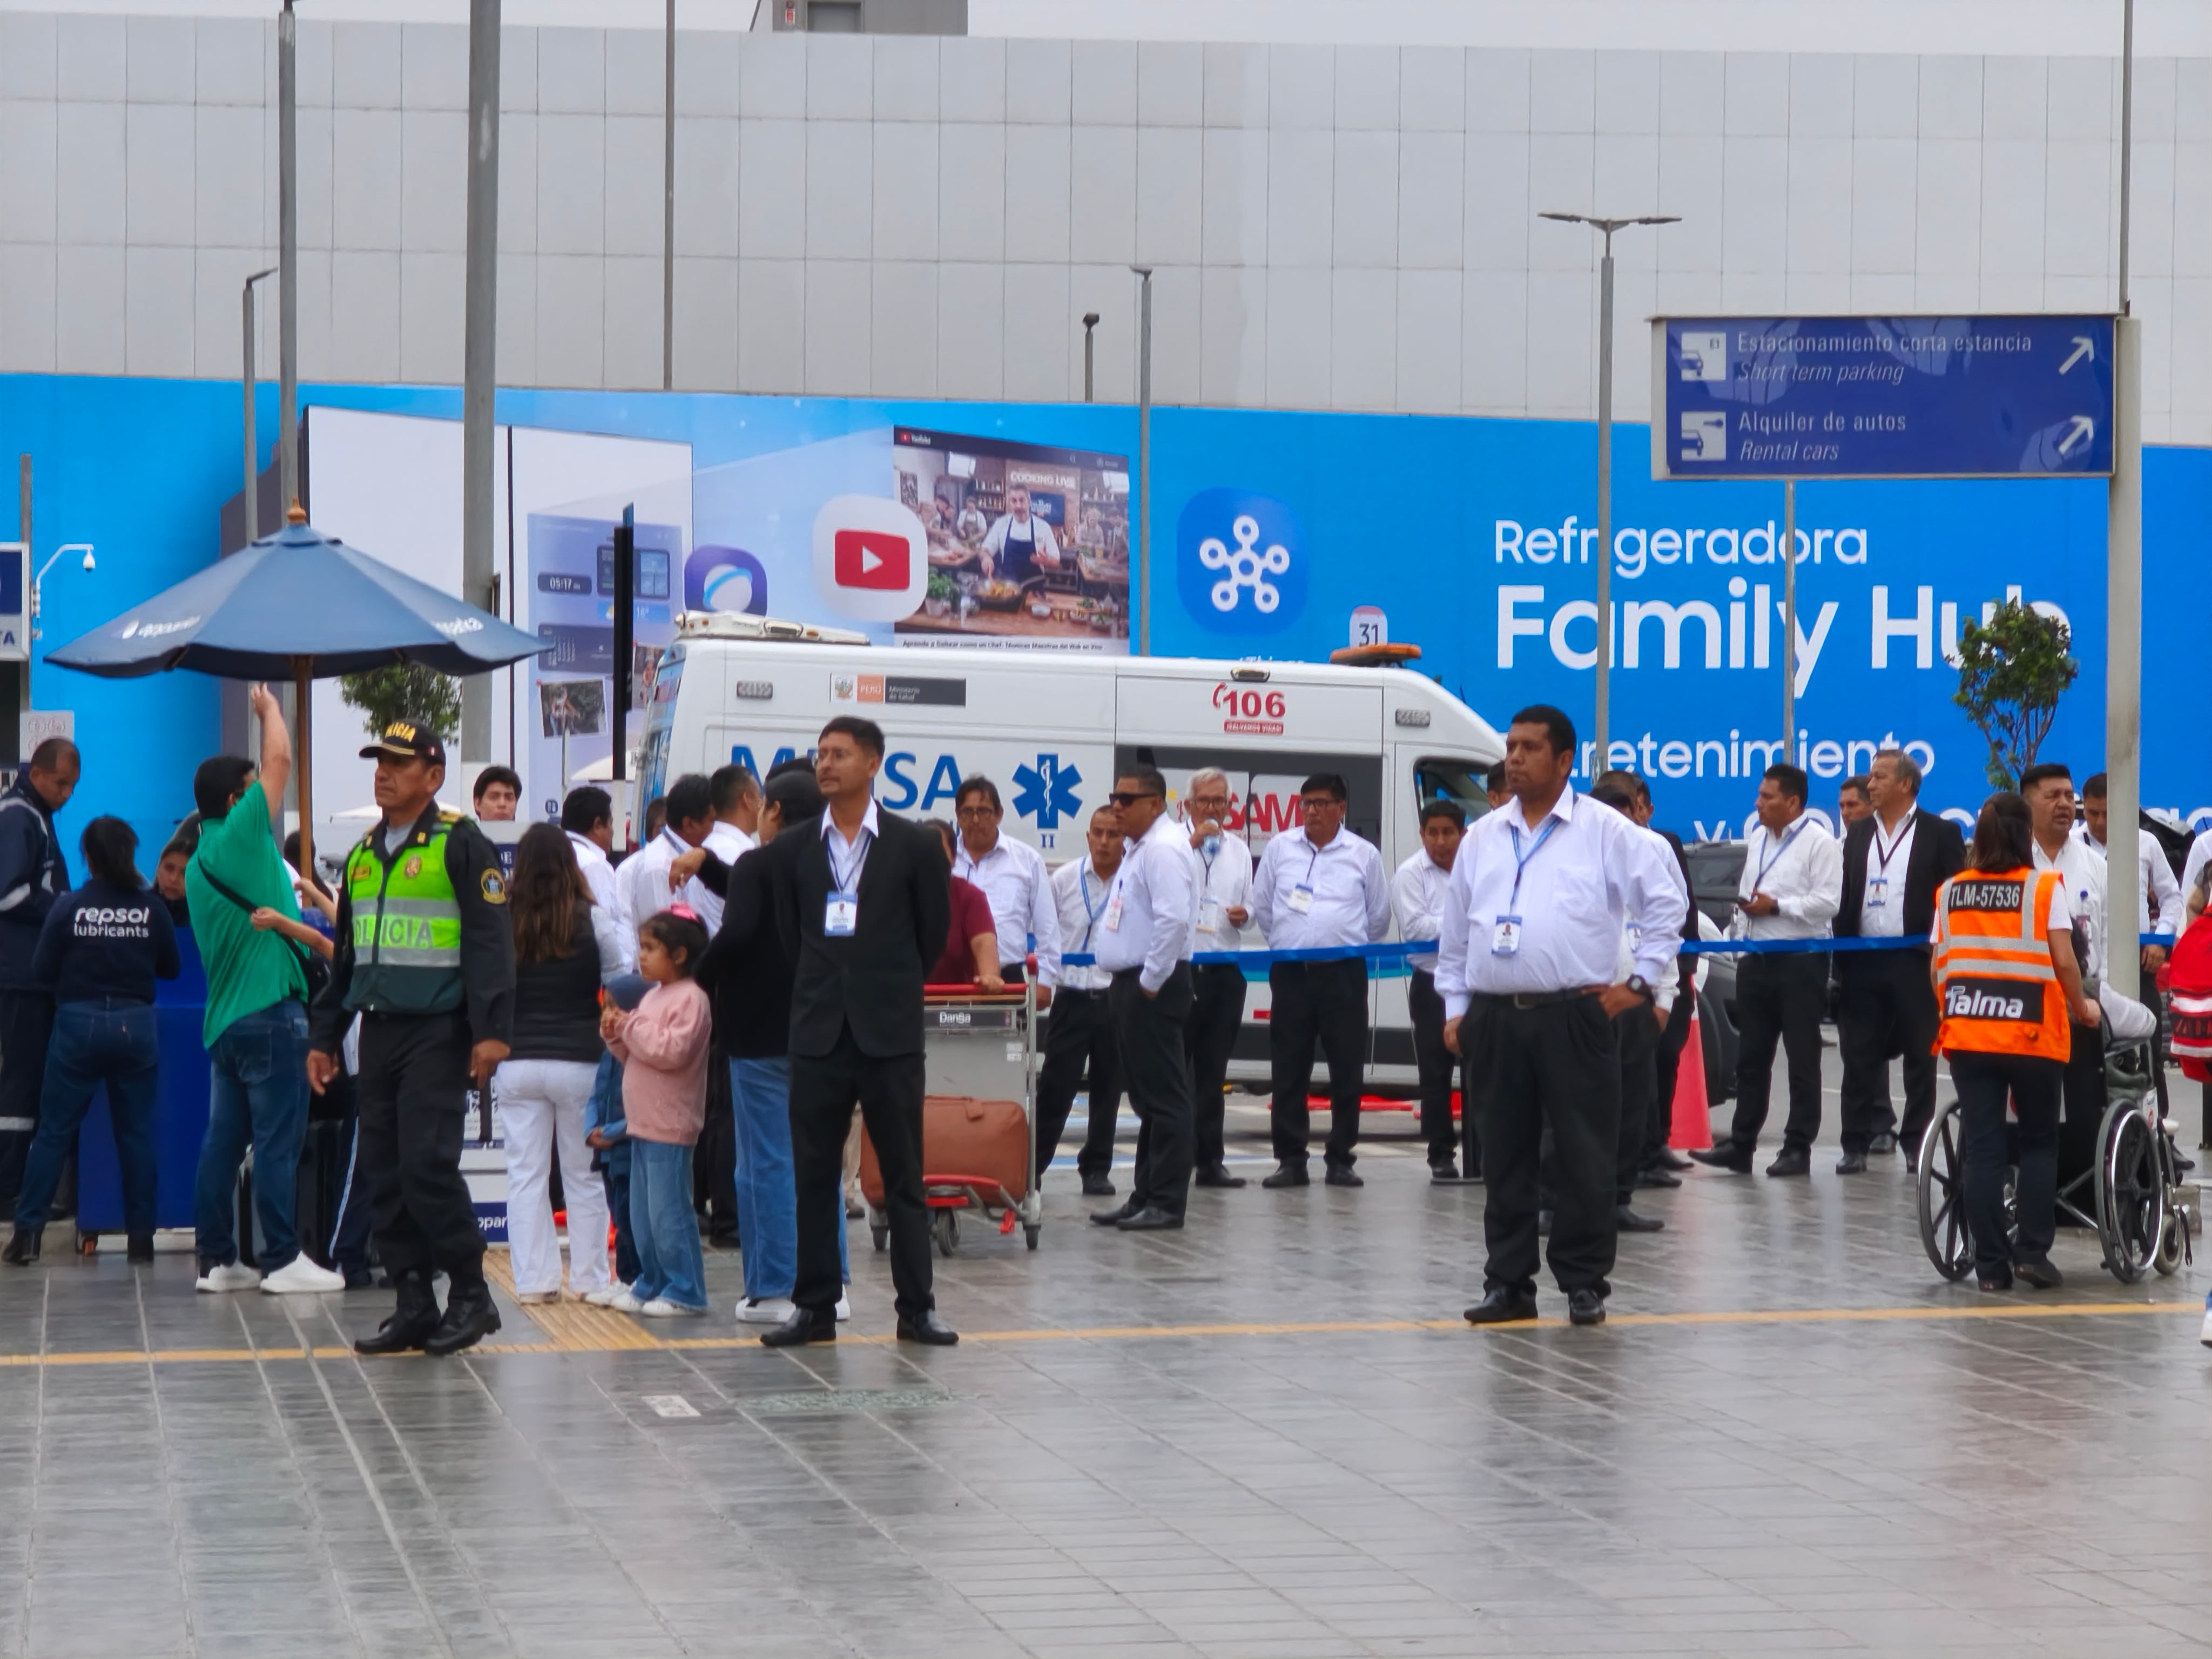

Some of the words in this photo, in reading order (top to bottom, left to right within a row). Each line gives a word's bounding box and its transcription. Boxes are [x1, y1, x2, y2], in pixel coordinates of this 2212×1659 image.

[1738, 332, 1892, 352] Estacionamiento
[1900, 335, 1946, 352] corta
[1954, 331, 2031, 352] estancia
[1739, 362, 1786, 381] Short
[1792, 364, 1831, 382] term
[1837, 361, 1904, 386] parking
[1738, 410, 1814, 436] Alquiler
[1824, 410, 1845, 431] de
[1853, 413, 1906, 431] autos
[1740, 440, 1798, 461] Rental
[1803, 444, 1839, 461] cars
[1495, 515, 1867, 579] Refrgeradora
[1358, 622, 1379, 646] 31
[1496, 576, 1839, 699] Family
[1871, 585, 2073, 671] Hub
[1223, 690, 1286, 718] 106
[1040, 834, 1055, 848] II
[1950, 884, 2021, 908] TLM-57536
[74, 906, 150, 927] repsol
[73, 922, 149, 939] lubricants
[1945, 985, 2024, 1019] Talma
